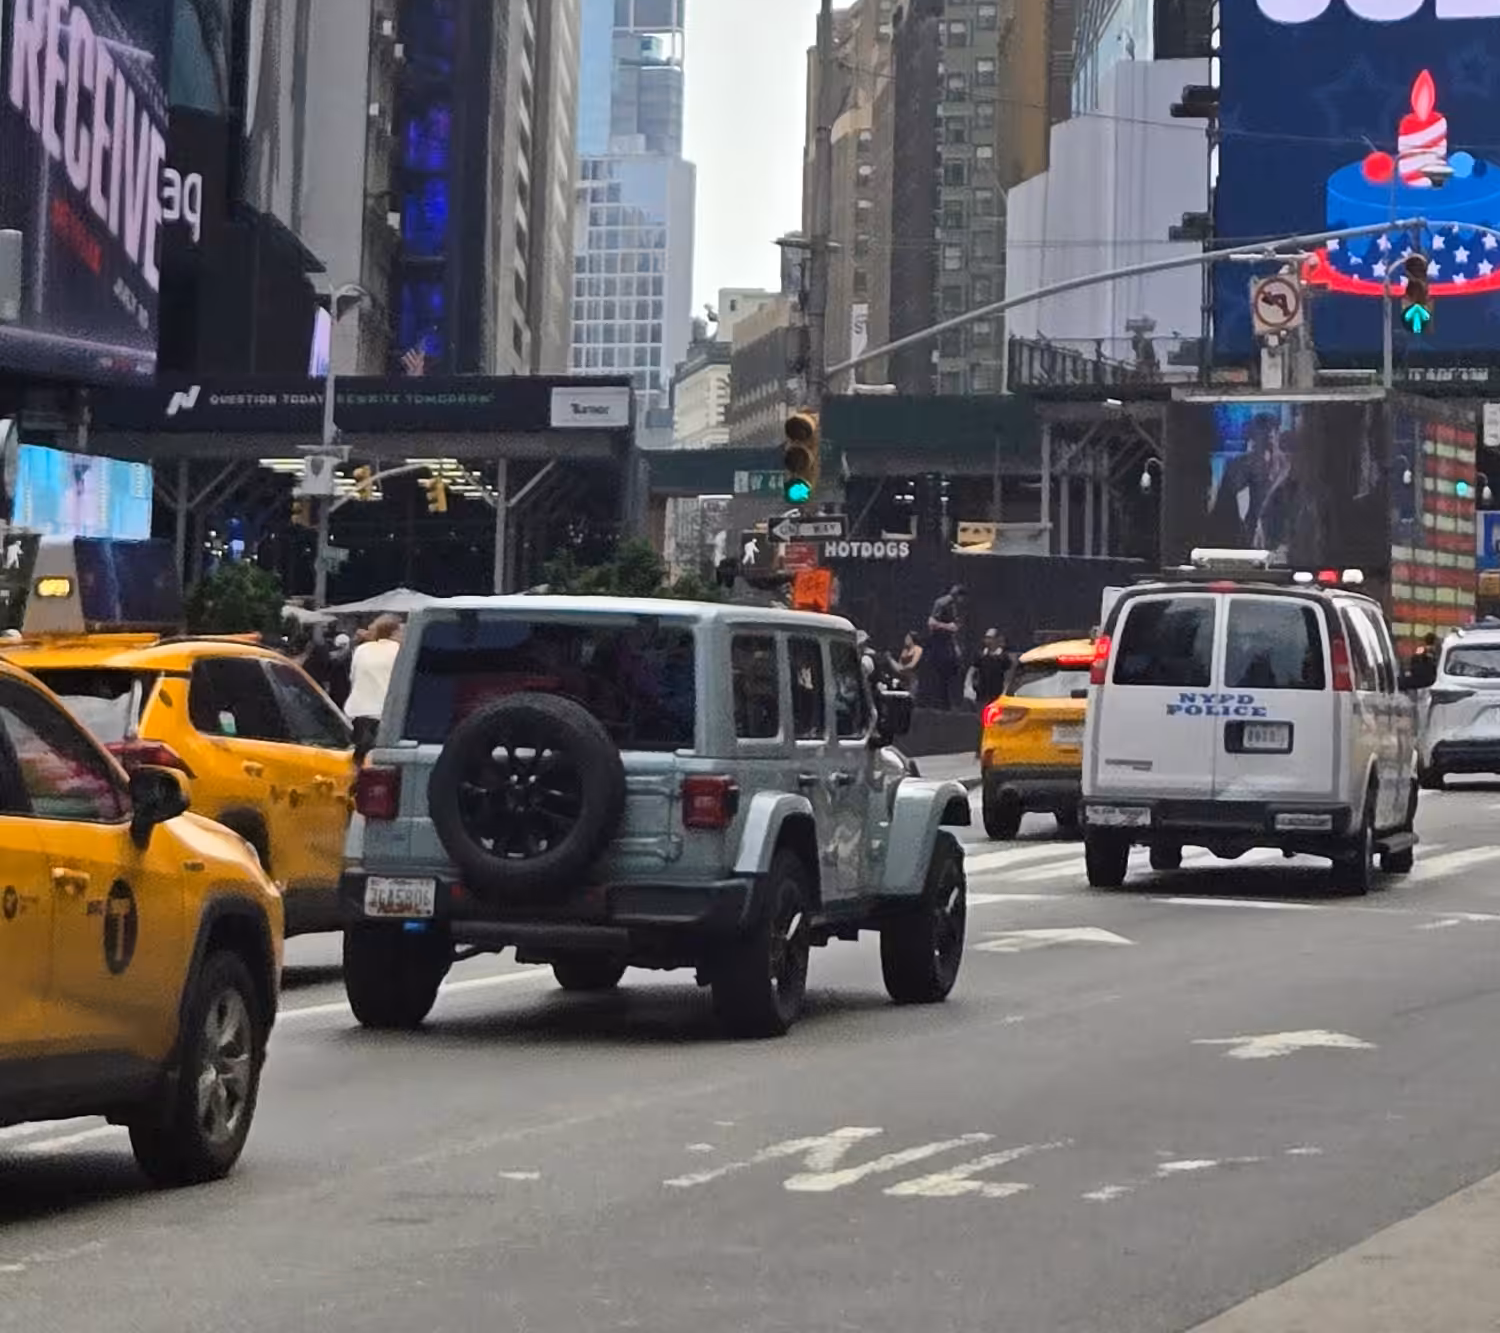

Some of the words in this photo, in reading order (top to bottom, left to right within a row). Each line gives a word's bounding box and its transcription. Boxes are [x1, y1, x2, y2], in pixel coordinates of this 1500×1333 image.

[209, 394, 277, 405] QUESTION
[283, 394, 324, 405] TODAY
[824, 541, 911, 558] HOTDOGS
[1179, 692, 1255, 704] NYPD
[1166, 704, 1267, 717] POLICE
